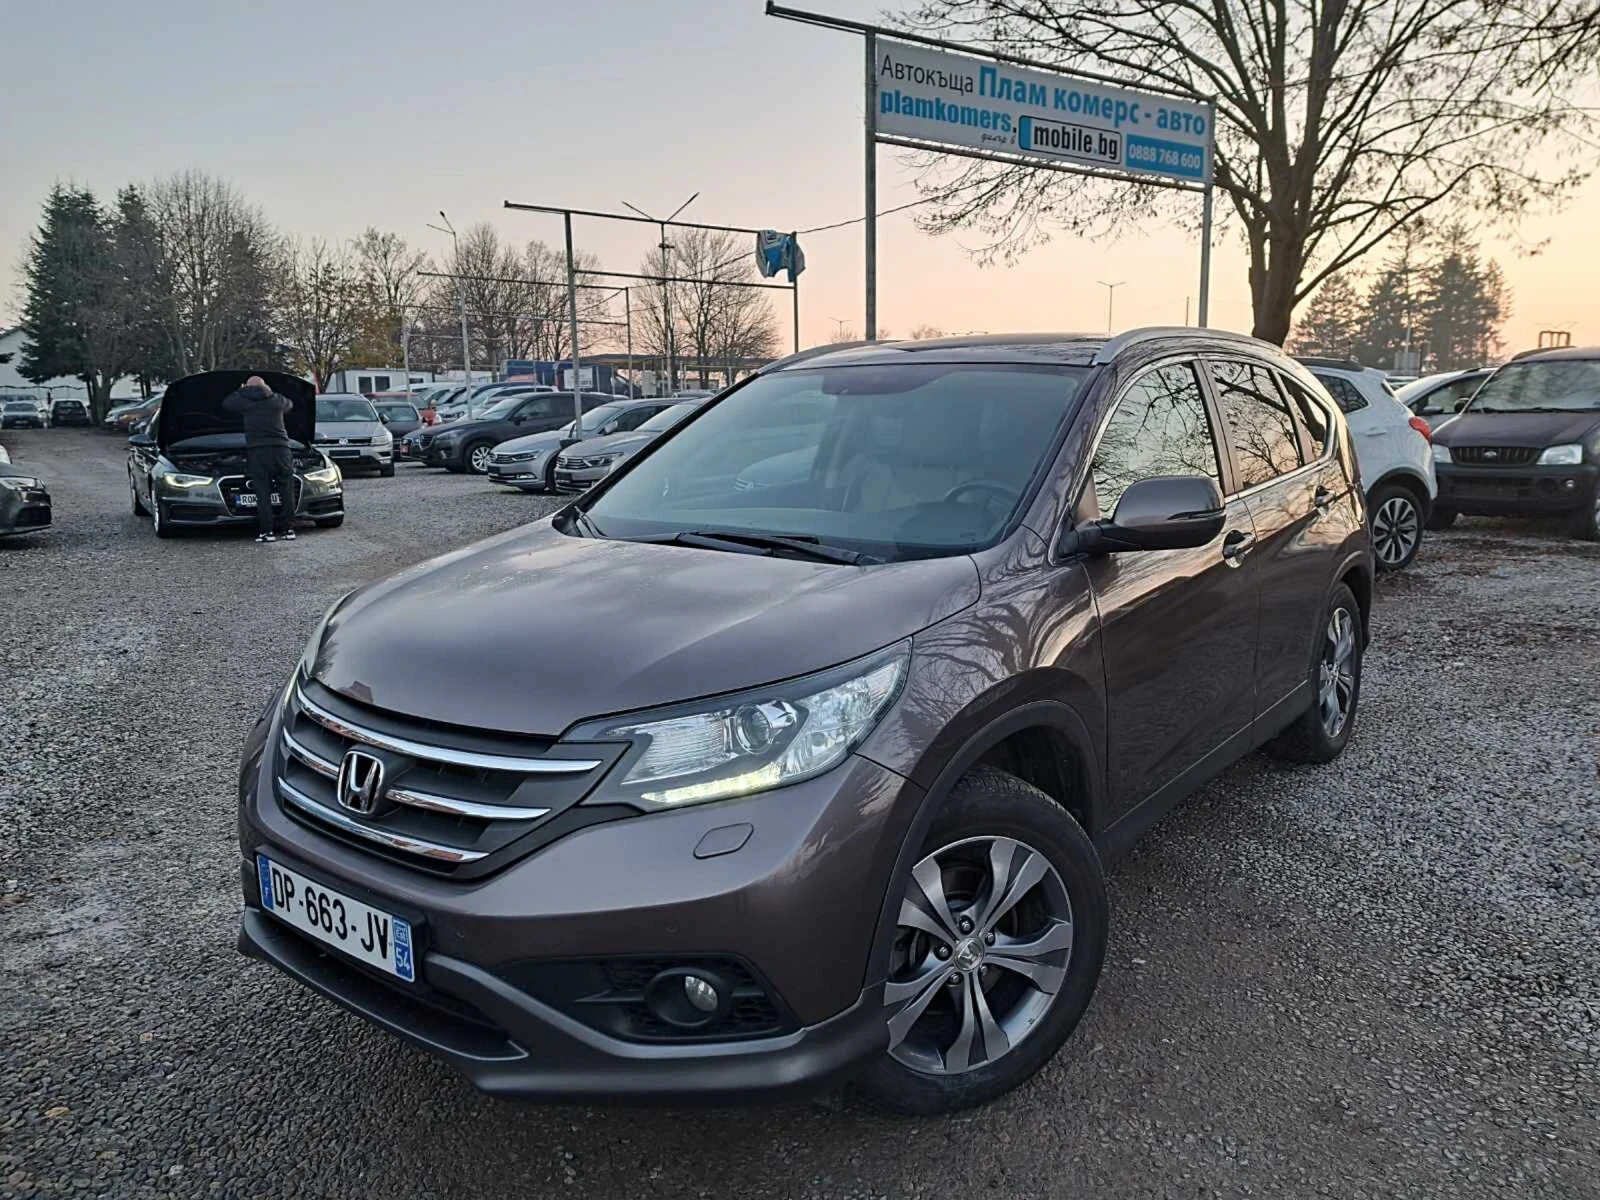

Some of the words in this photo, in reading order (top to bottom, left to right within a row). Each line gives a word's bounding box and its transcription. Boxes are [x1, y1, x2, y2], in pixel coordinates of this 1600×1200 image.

[881, 54, 974, 96] Автокъща
[979, 66, 1047, 107] Плам
[1053, 88, 1139, 127] комерс
[1157, 108, 1205, 135] авто
[1034, 126, 1118, 160] mobile.bg
[1128, 143, 1157, 162] 0888
[1159, 149, 1179, 165] 768
[1181, 152, 1201, 169] 600
[272, 867, 389, 959] DP-663-JV
[396, 946, 410, 971] 54
